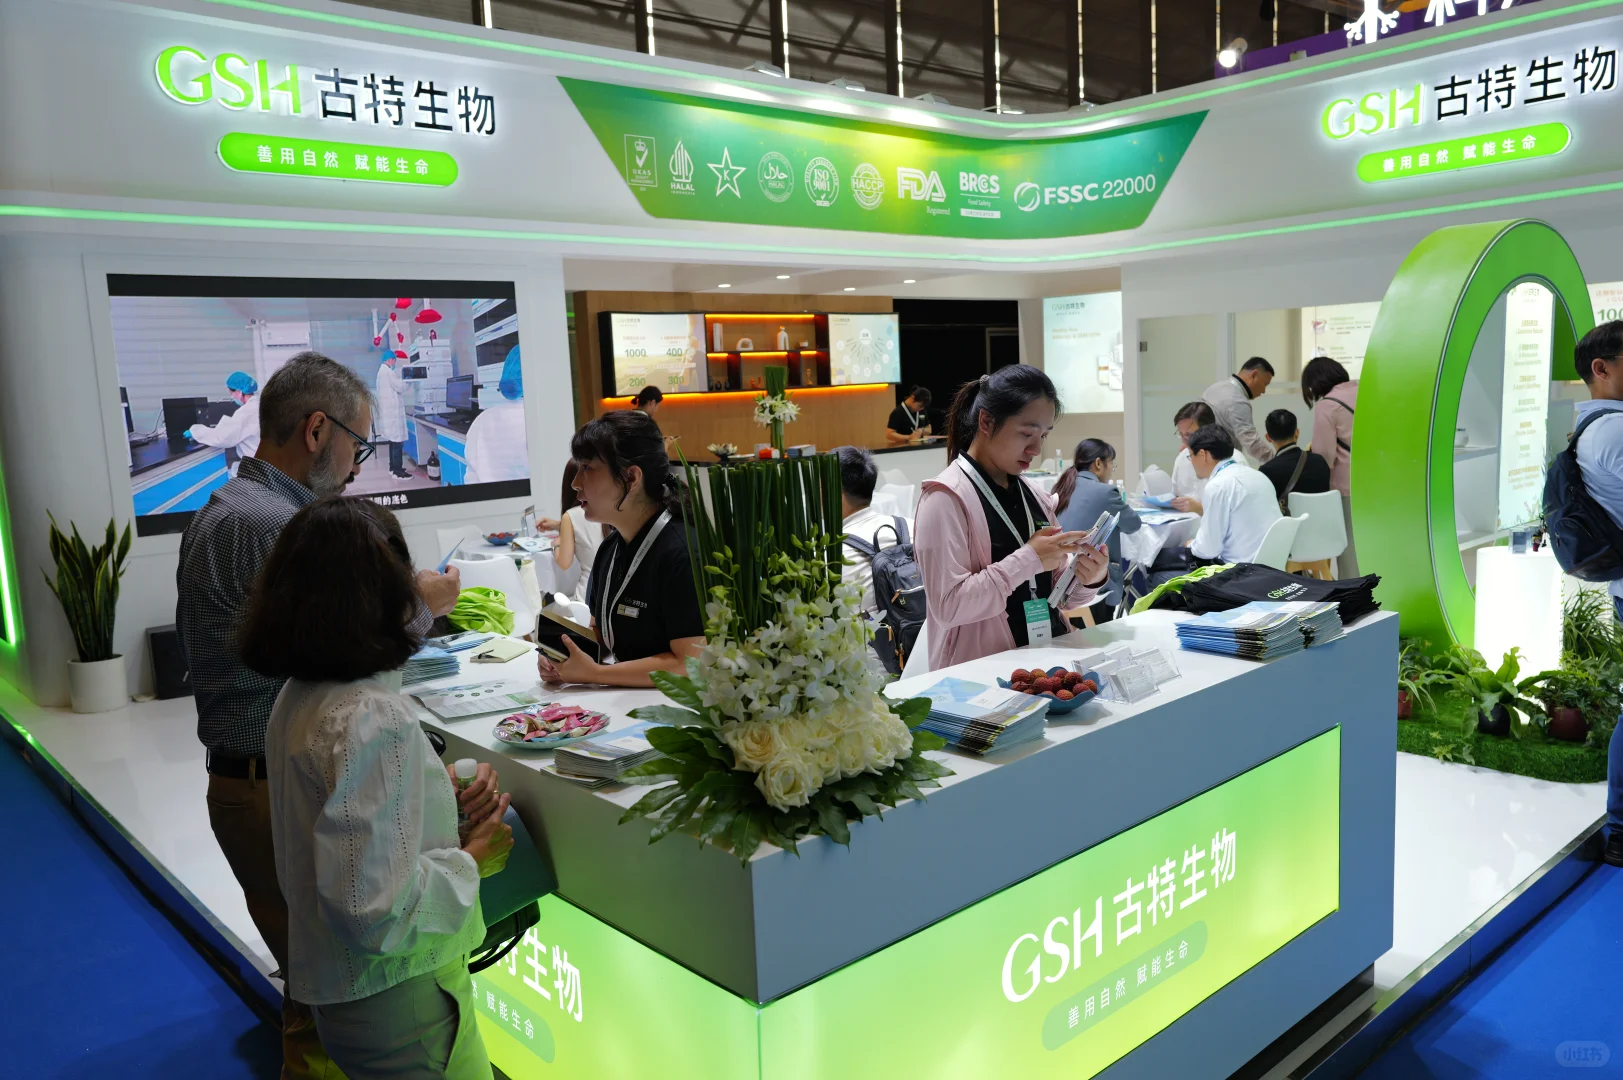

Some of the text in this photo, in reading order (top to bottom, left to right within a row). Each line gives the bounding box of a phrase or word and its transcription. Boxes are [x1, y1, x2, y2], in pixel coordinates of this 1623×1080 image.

[155, 45, 496, 137] GSH 古特生物
[1321, 45, 1618, 140] GSH 古特生物
[257, 145, 430, 176] 善用自然 赋能生命
[1383, 134, 1537, 173] 善用自然 赋能生命
[632, 168, 652, 176] UKAS
[670, 182, 695, 191] HALAL
[723, 169, 730, 181] K
[813, 180, 831, 191] 9001
[814, 168, 829, 180] ISO
[852, 178, 883, 191] HACCP
[897, 166, 946, 202] FDA
[1044, 173, 1156, 205] FSSC 22000
[624, 347, 683, 357] 1000 400
[629, 376, 684, 387] 200 300
[1001, 827, 1237, 1003] GSH 古特生物
[1068, 940, 1189, 1029] 善用自然 赋能生命
[486, 990, 535, 1040] 赋能生命
